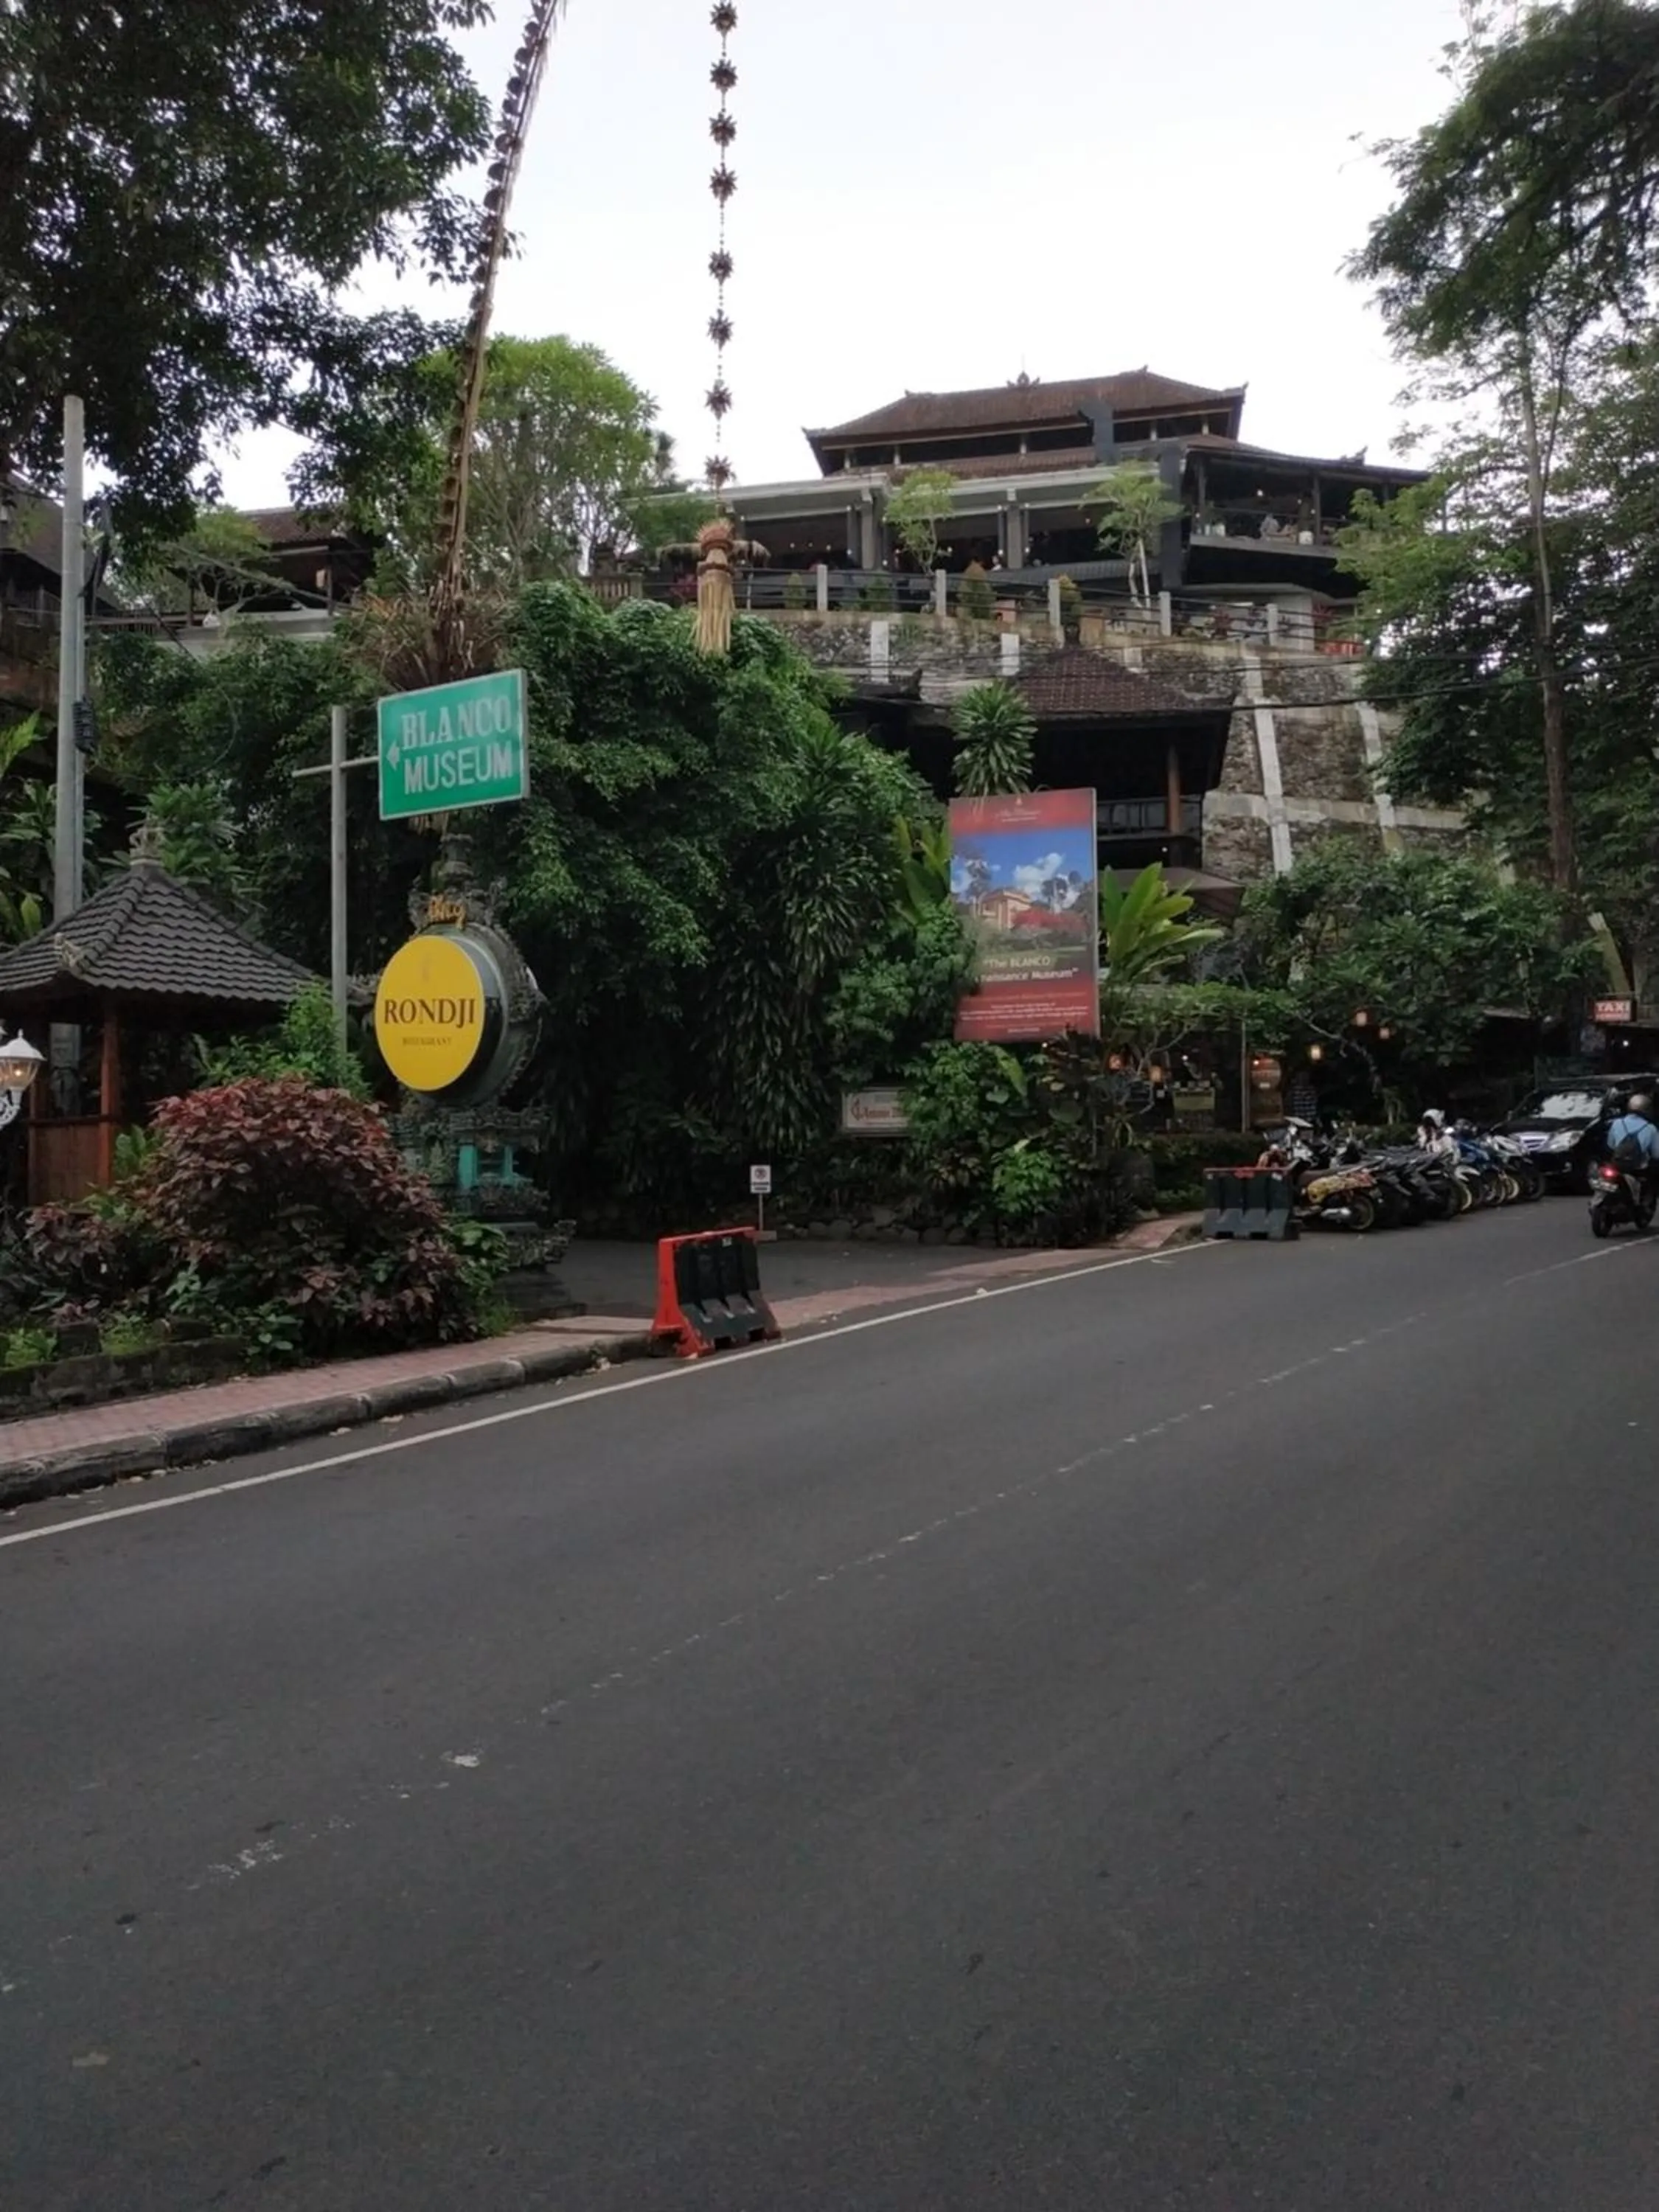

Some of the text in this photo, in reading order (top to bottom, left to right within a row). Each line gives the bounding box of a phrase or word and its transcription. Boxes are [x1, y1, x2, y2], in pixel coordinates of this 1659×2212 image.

[402, 695, 512, 750] BLANCO
[405, 740, 512, 795] MUSEUM
[384, 998, 476, 1029] RONDJI
[1596, 1001, 1630, 1012] TAXI
